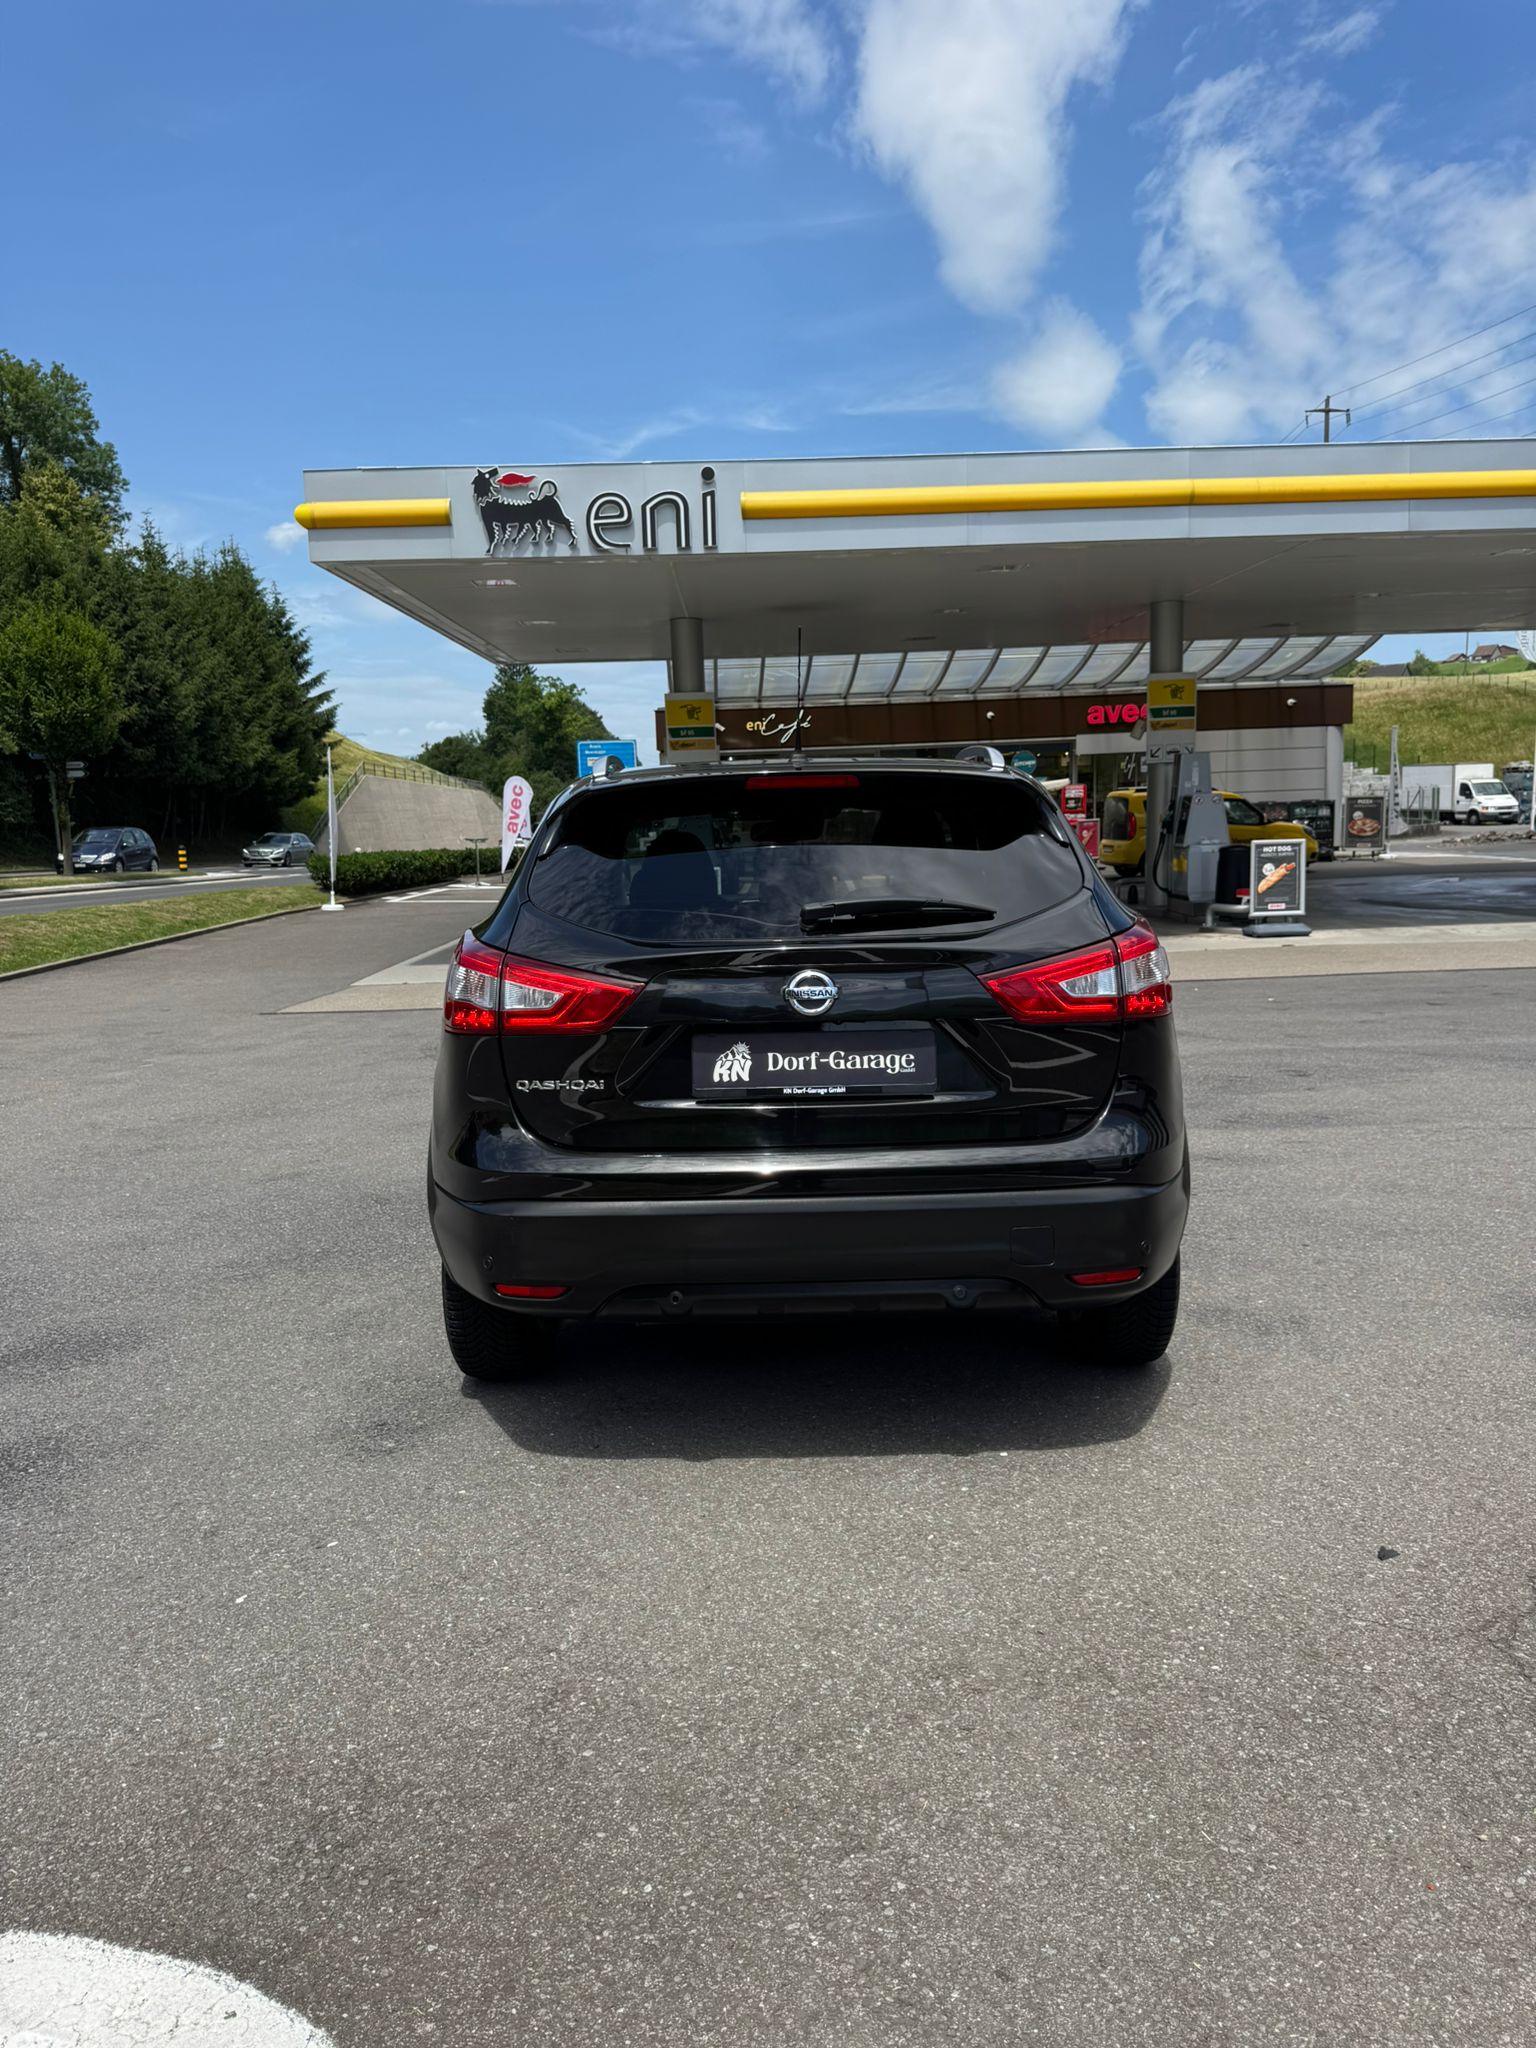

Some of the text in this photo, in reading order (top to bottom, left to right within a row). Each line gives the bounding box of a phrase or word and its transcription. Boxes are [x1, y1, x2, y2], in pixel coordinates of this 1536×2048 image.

[586, 466, 718, 549] eni
[507, 785, 524, 834] avec
[792, 990, 833, 998] NISSAN
[713, 1059, 752, 1082] KN
[767, 1051, 915, 1074] Dorf-Garage
[793, 1086, 827, 1095] Dorf-Garage
